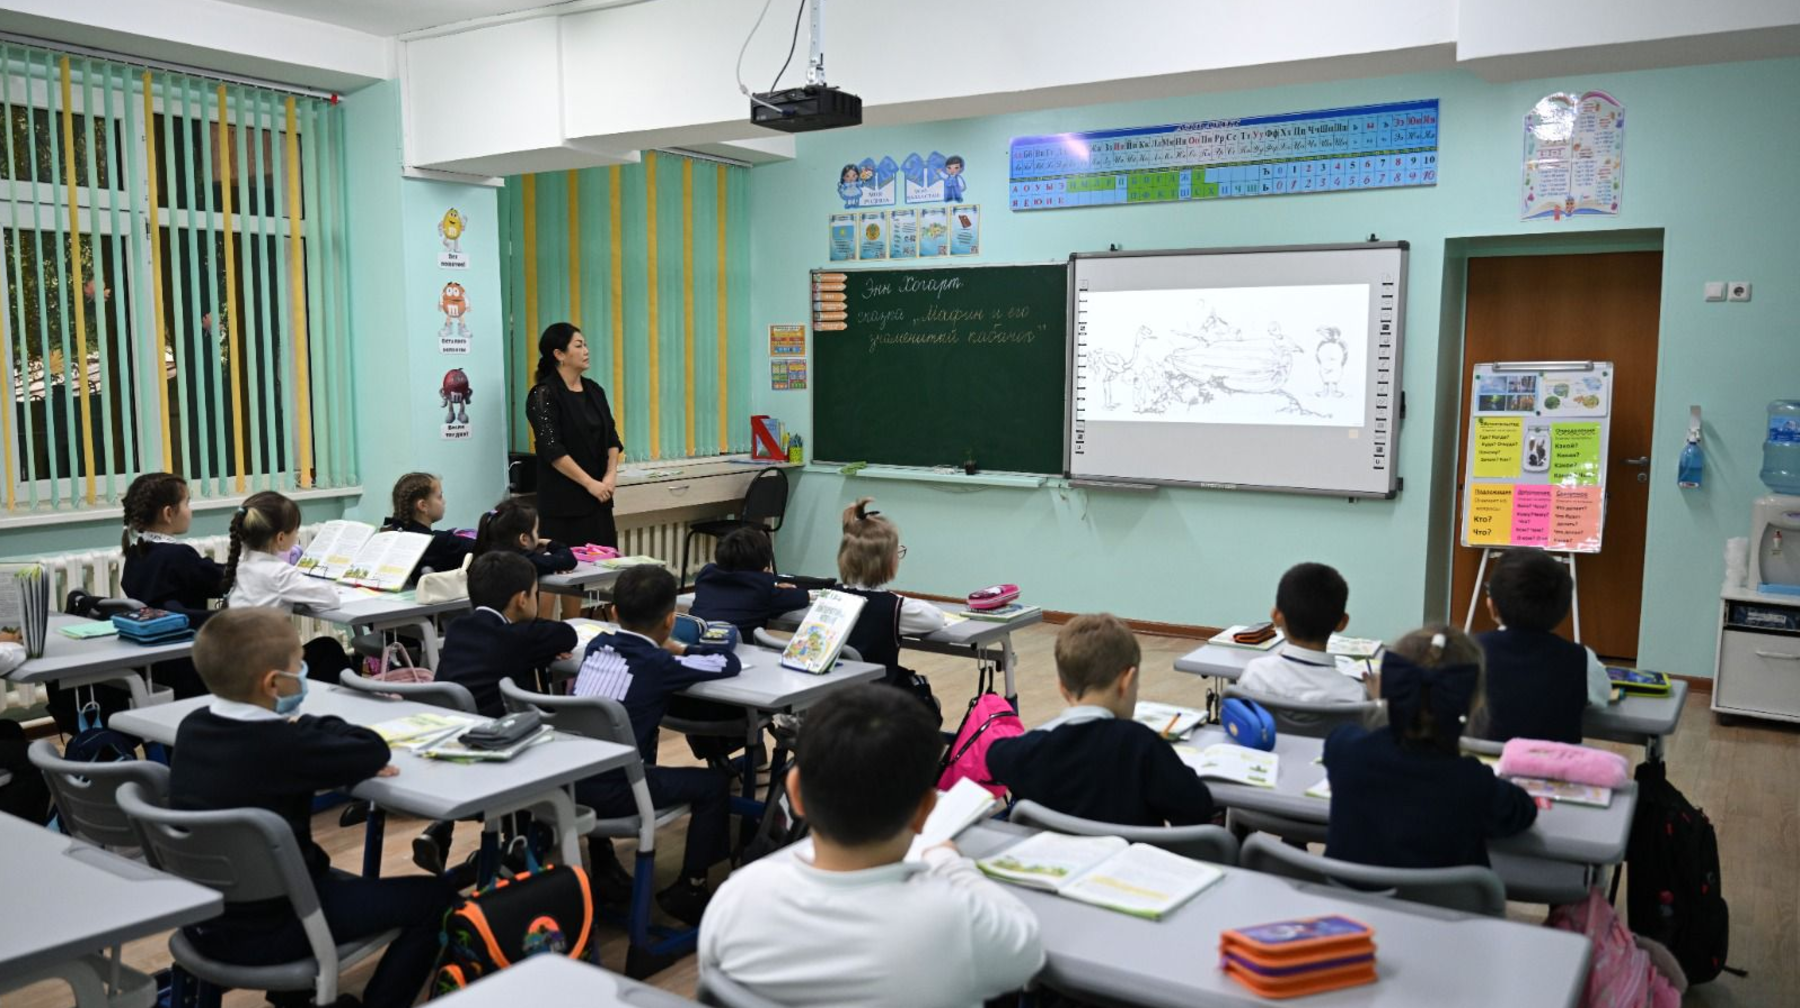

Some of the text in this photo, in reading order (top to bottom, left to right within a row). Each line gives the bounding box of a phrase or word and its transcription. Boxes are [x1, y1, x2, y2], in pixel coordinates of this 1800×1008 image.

[1214, 134, 1225, 144] Рр
[1226, 132, 1236, 140] Сс
[1252, 130, 1264, 140] Уу
[1265, 129, 1279, 140] Фф
[1262, 168, 1270, 176] Ъ
[1292, 166, 1296, 174] 1
[1306, 164, 1312, 172] 2
[1320, 164, 1326, 172] 3
[1350, 161, 1356, 169] 5
[1380, 159, 1386, 167] 7
[1395, 158, 1402, 166] 8
[1410, 156, 1416, 164] 9
[1424, 156, 1436, 164] 10
[1276, 182, 1283, 190] 0
[1291, 180, 1297, 189] 1
[1305, 178, 1312, 188] 2
[1320, 178, 1326, 186] 3
[1334, 177, 1340, 186] 4
[1348, 176, 1356, 186] 5
[1364, 176, 1370, 184] 6
[1379, 174, 1386, 183] 7
[1394, 172, 1401, 182] 8
[1422, 170, 1436, 180] 10
[862, 275, 961, 300] Энн Хогарт
[858, 308, 905, 331] сказка
[1006, 305, 1030, 318] его
